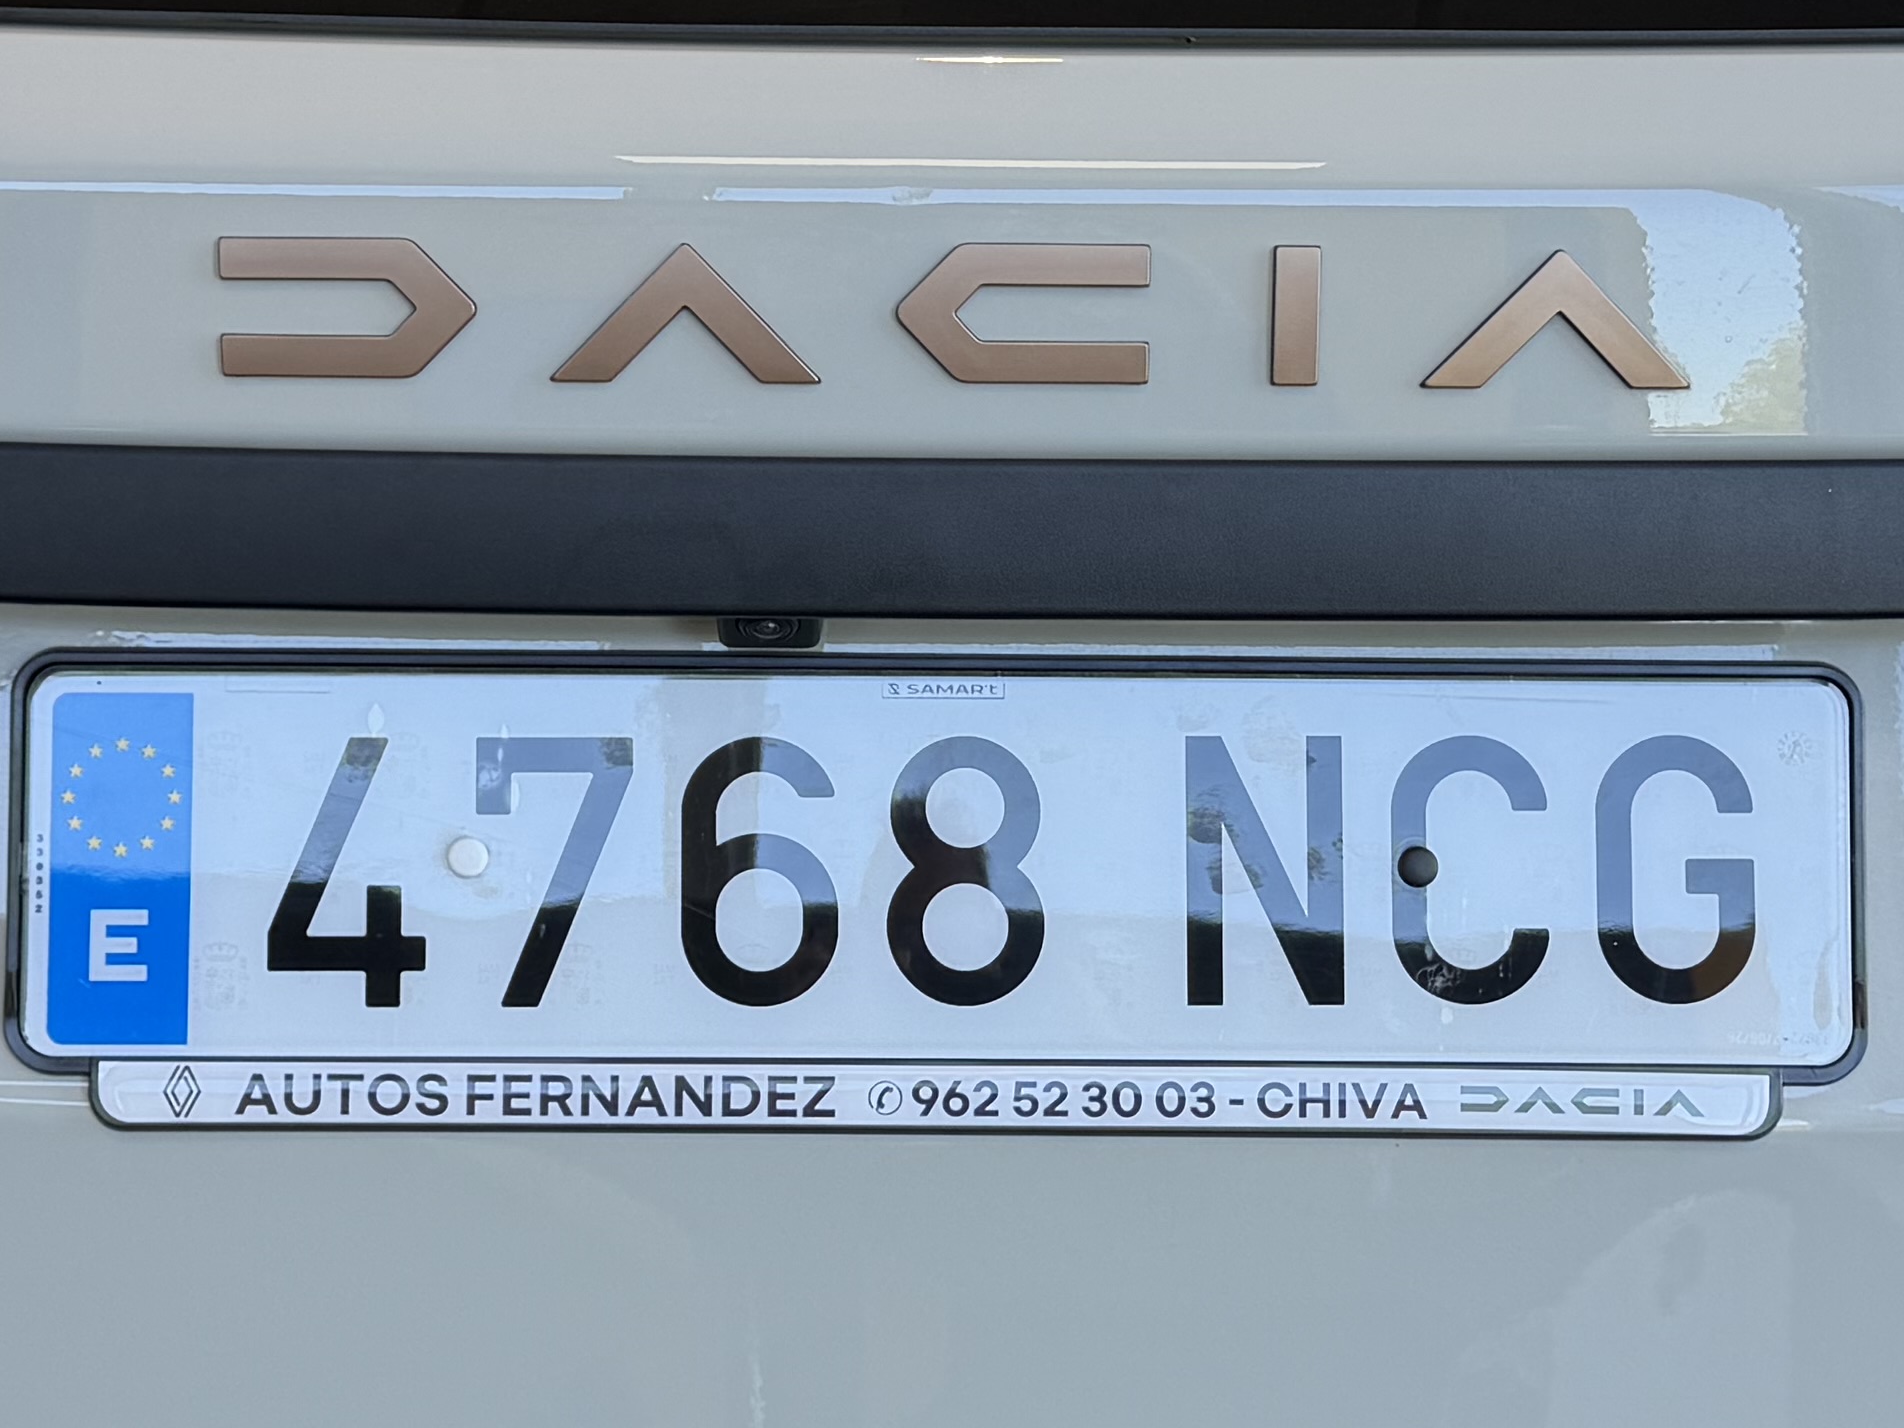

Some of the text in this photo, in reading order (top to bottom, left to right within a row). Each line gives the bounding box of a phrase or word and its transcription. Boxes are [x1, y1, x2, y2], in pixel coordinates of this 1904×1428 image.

[217, 236, 1690, 390] DACIA
[266, 734, 1757, 1009] 4768 NCG
[88, 909, 149, 982] E
[234, 1073, 450, 1117] AUTOS
[465, 1074, 836, 1118] FERNANDEZ
[910, 1079, 1000, 1119] 962
[1011, 1080, 1068, 1119] 52
[1080, 1080, 1143, 1120] 30
[1154, 1081, 1218, 1120] 03
[1256, 1081, 1428, 1121] CHIVA
[1459, 1084, 1705, 1119] DACIA
